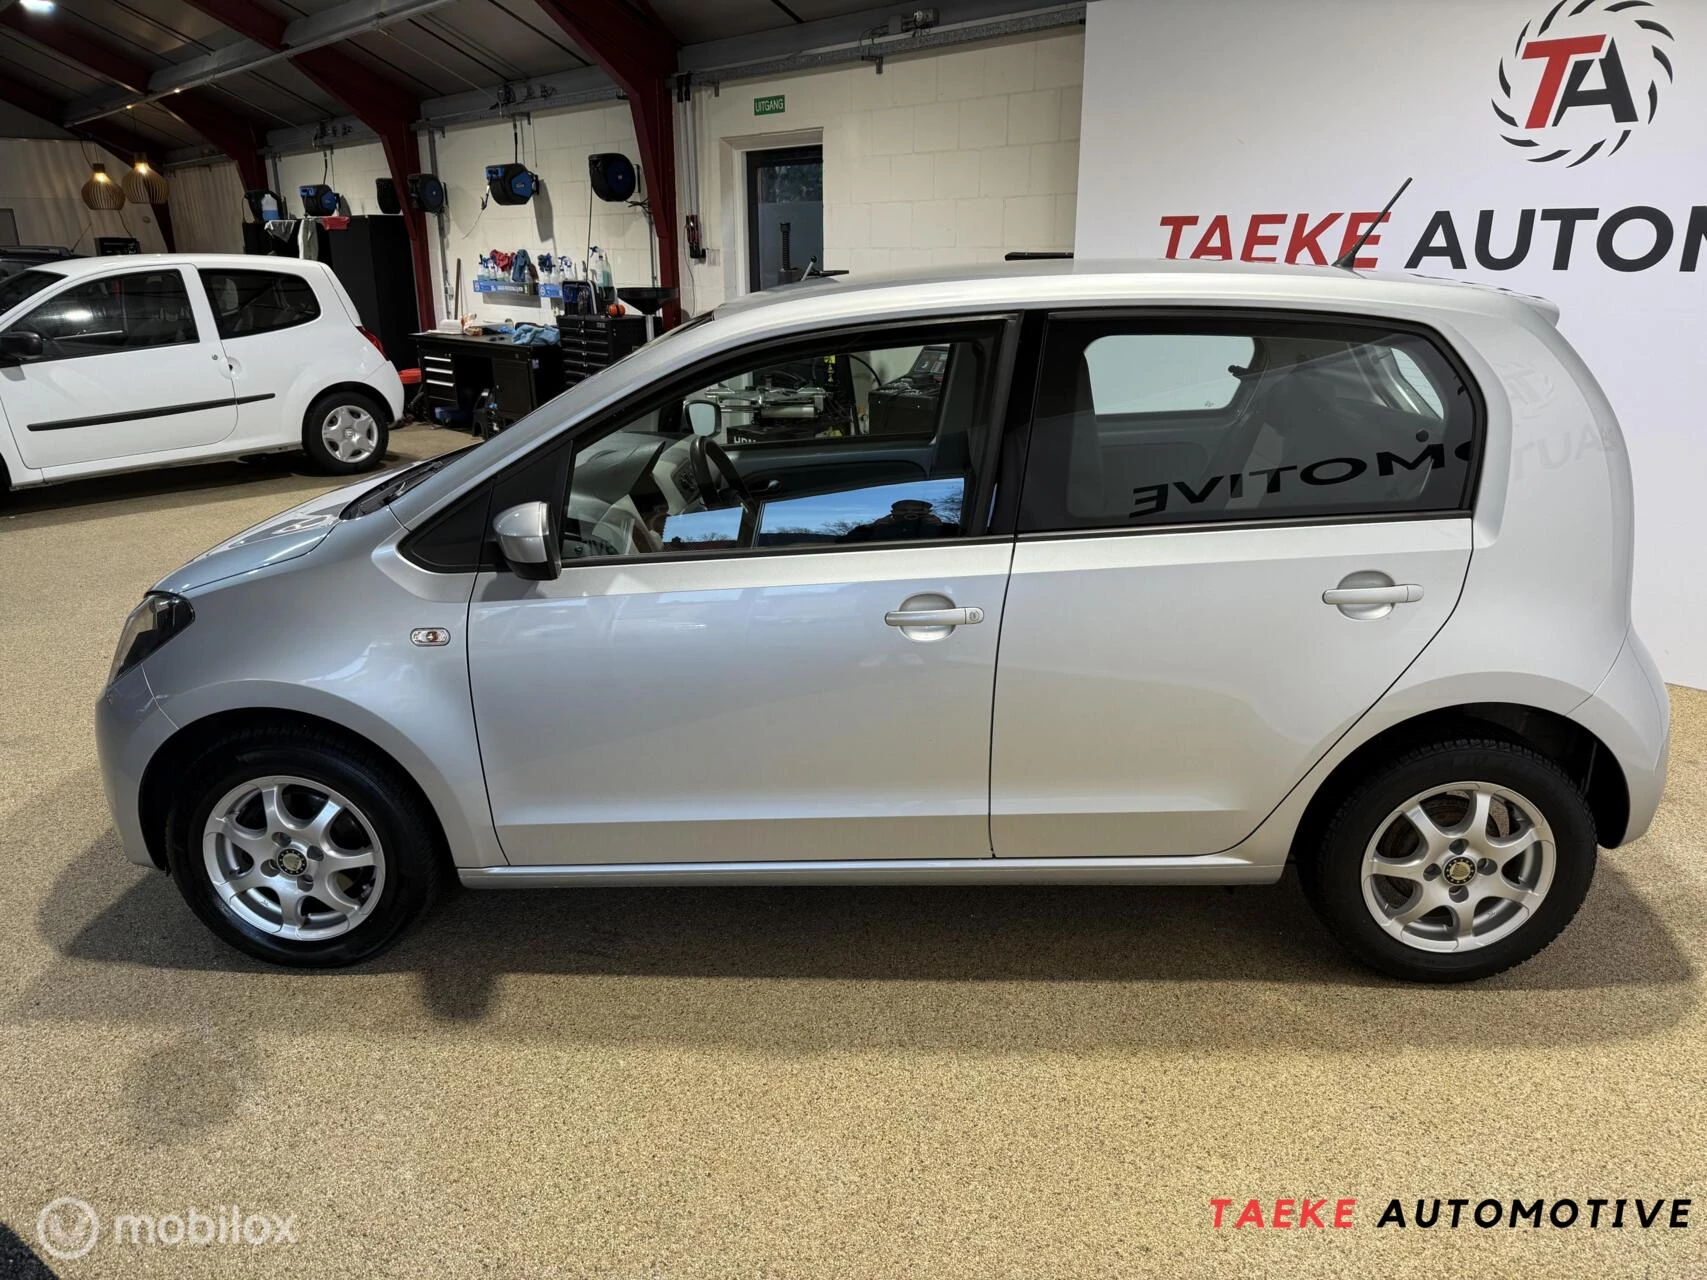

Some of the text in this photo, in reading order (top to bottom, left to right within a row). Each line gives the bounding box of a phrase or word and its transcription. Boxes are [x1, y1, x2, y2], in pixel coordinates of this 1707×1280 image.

[755, 99, 784, 112] UITGANG
[1521, 34, 1639, 129] TA
[1160, 211, 1392, 269] TAEKE
